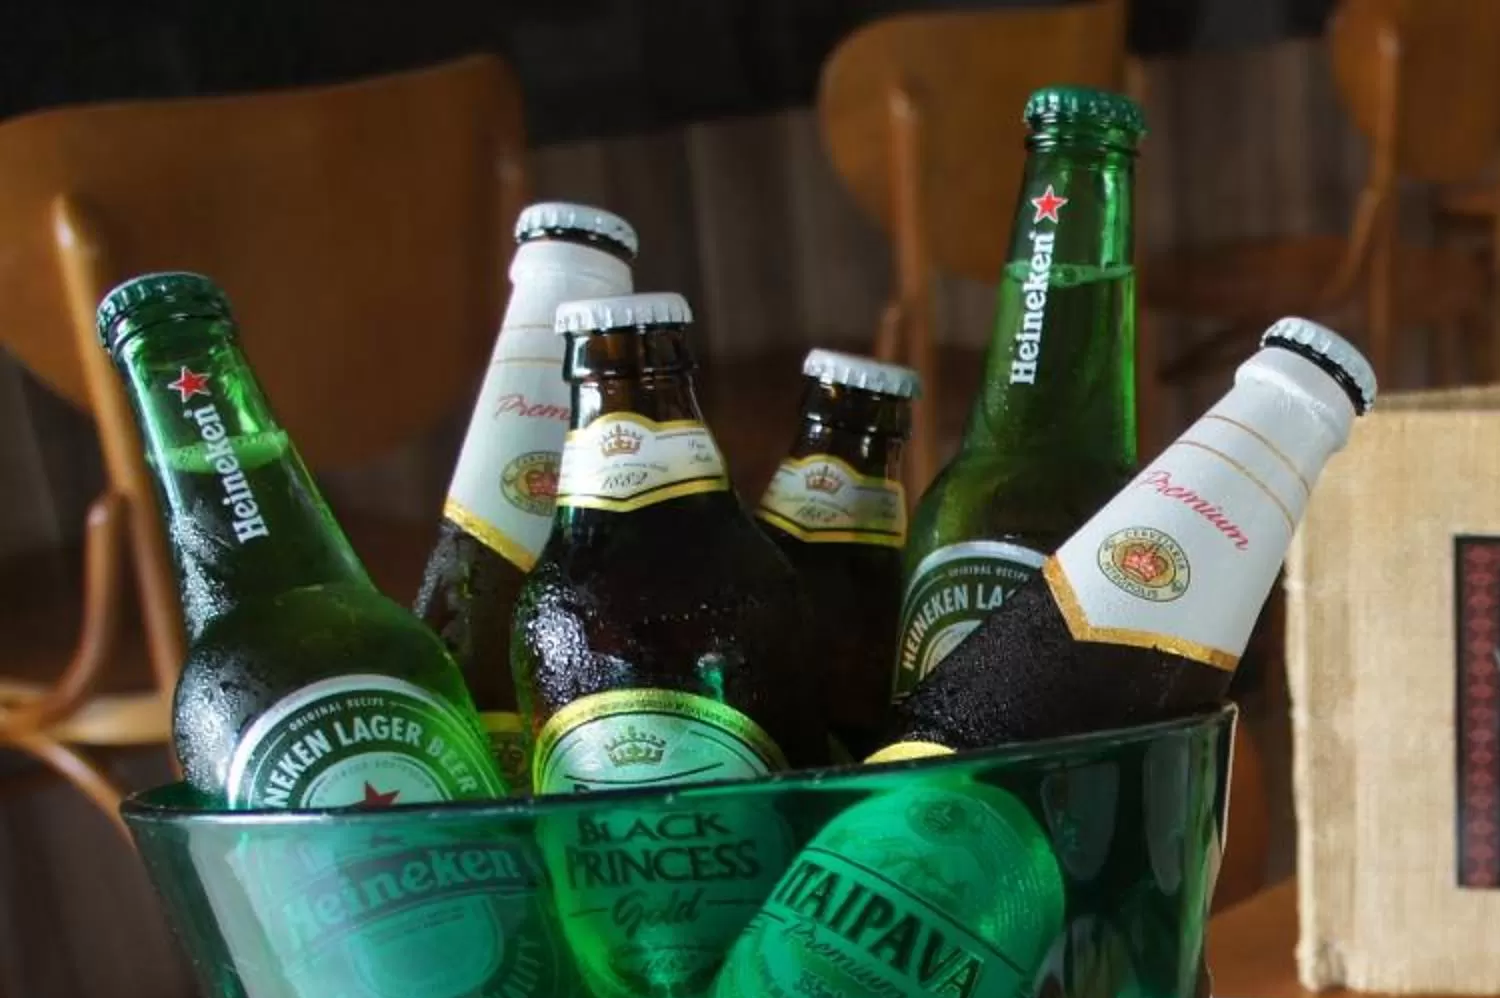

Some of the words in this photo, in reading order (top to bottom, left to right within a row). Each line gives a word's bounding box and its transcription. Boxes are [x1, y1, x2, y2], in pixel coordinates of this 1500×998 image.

[1009, 232, 1056, 386] Heineken
[194, 404, 270, 544] Heineken
[1138, 470, 1249, 550] Premium
[995, 566, 1032, 582] RECIPE
[901, 583, 969, 672] HEINEKEN
[976, 583, 1016, 610] LA
[332, 714, 424, 748] LAGER
[424, 735, 479, 794] BEER
[564, 840, 763, 890] PRINCESS
[576, 811, 734, 846] BLACK
[282, 848, 522, 953] Heineken
[611, 886, 707, 939] Gold
